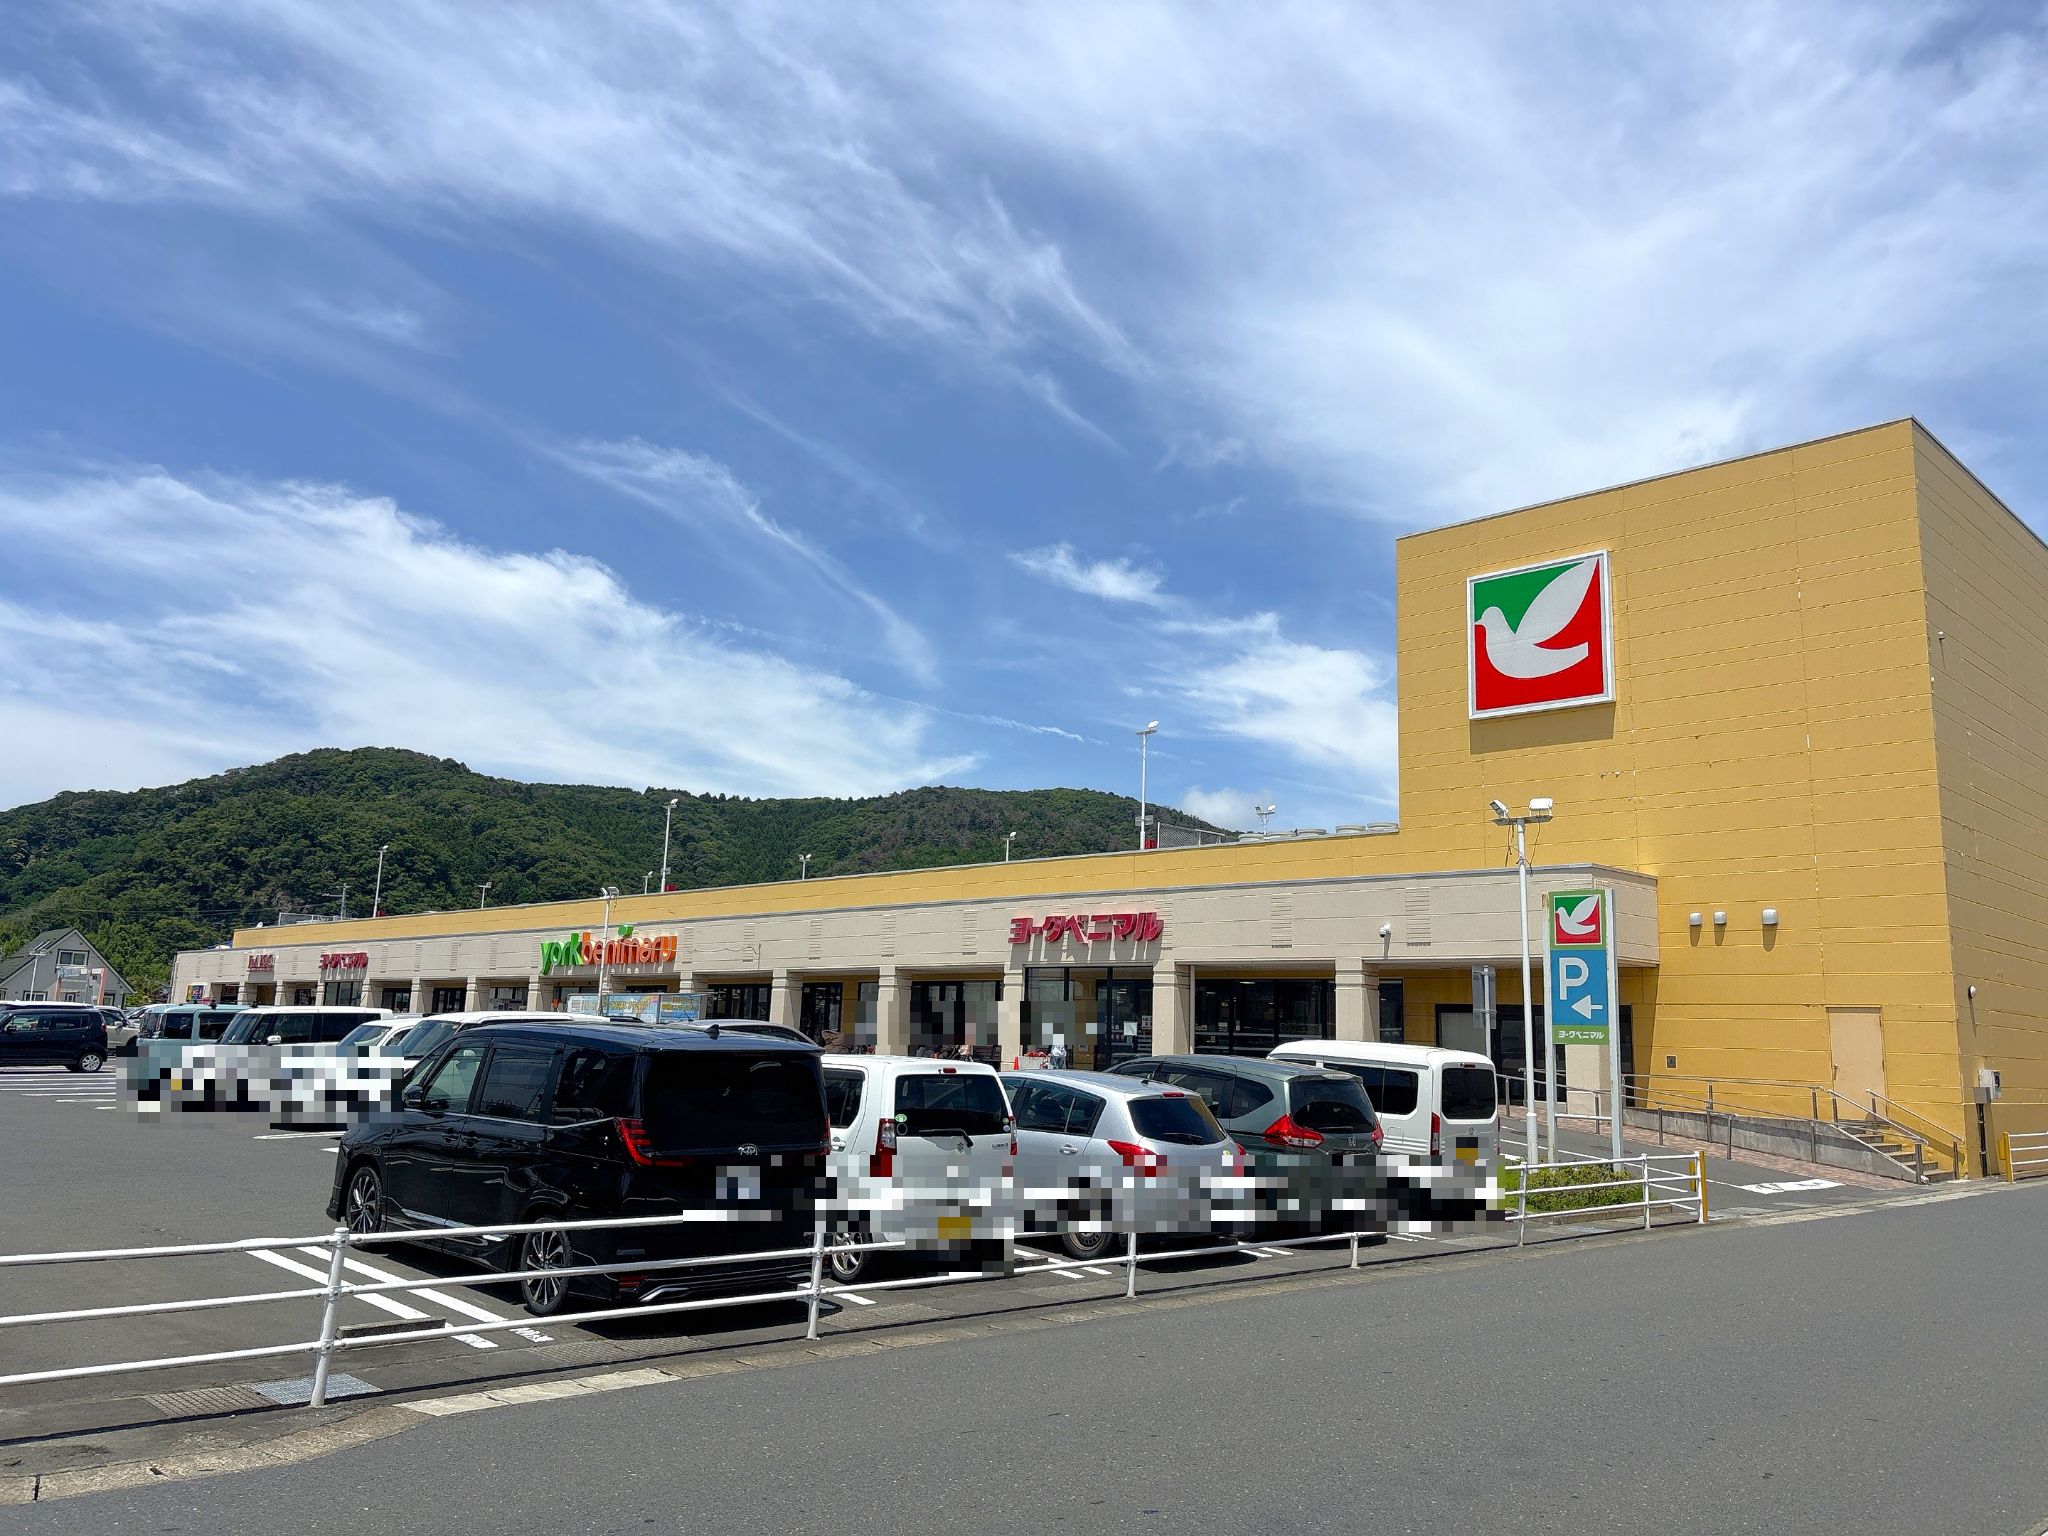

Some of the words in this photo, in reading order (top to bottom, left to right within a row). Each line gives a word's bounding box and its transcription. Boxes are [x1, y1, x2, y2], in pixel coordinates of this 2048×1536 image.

[1008, 912, 1164, 943] ヨークベニマル
[1559, 957, 1589, 1000] P
[1558, 1030, 1605, 1040] ヨークベニマル
